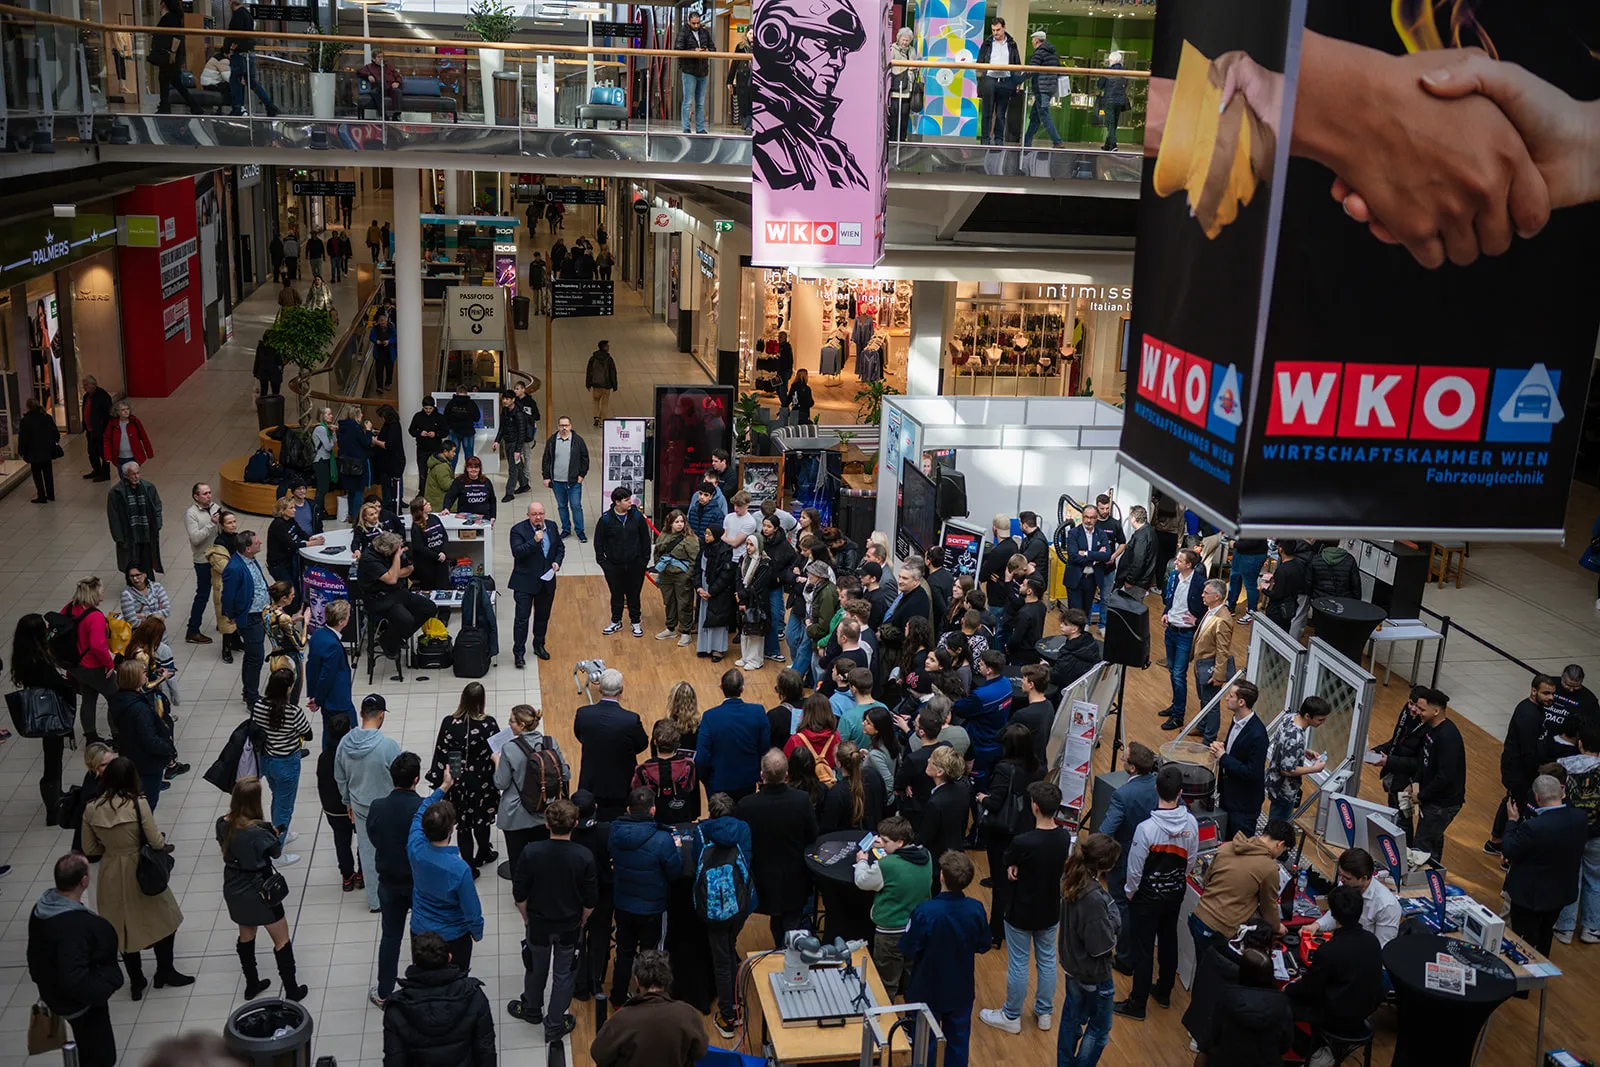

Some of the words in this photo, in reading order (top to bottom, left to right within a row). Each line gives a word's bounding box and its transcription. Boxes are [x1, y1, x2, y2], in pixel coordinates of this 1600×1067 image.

[766, 223, 834, 243] WKO
[841, 230, 860, 238] WIEN
[32, 240, 70, 266] PALMERS
[459, 293, 494, 301] PASSFOTOS
[816, 289, 850, 300] Italian
[854, 294, 896, 304] lingerie
[1038, 284, 1132, 299] intimiss
[1090, 301, 1123, 312] Italian
[1141, 342, 1207, 415] WKO
[1277, 371, 1476, 431] WKO
[1211, 442, 1234, 467] WIEN
[1262, 444, 1492, 466] WIRTSCHAFTSKAMMER
[1501, 451, 1549, 467] WIEN
[1426, 468, 1545, 487] Fahrzeugtechnik
